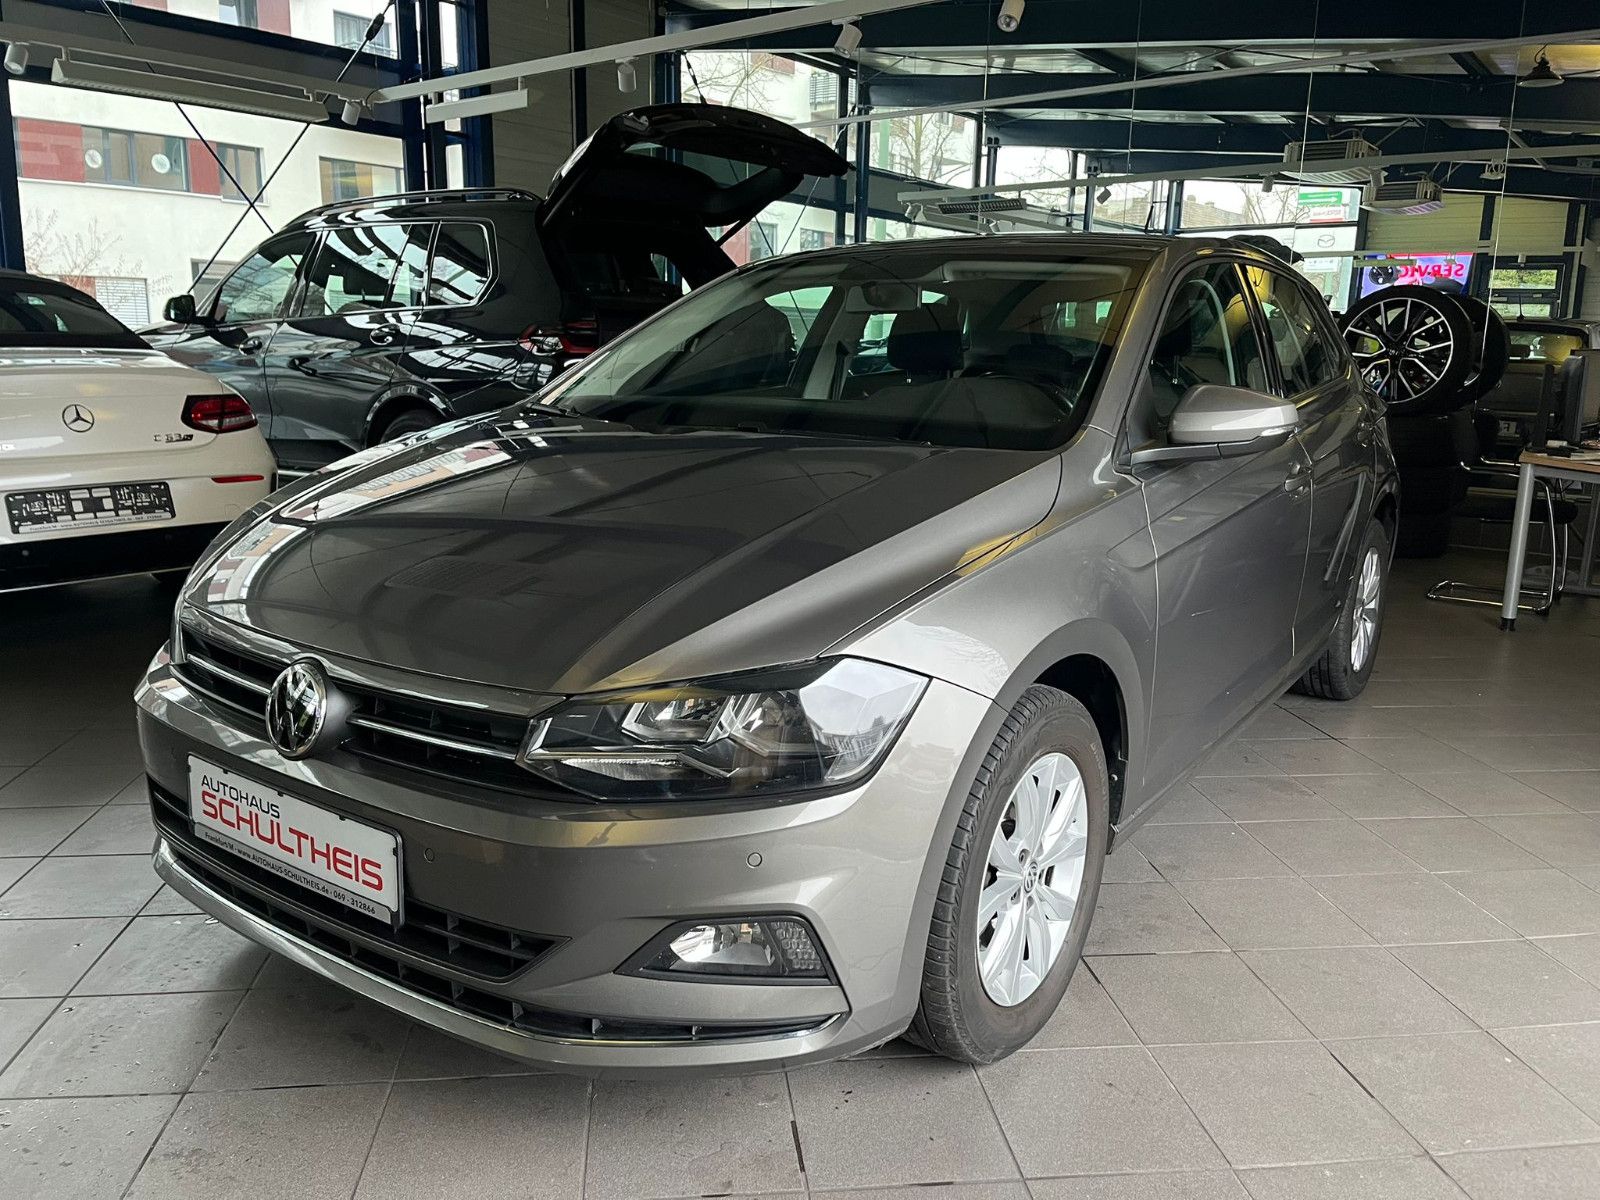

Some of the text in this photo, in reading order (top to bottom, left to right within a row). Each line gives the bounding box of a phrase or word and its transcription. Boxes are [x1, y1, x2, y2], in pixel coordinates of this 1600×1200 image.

[201, 774, 281, 819] AUTOHAUS
[201, 790, 383, 892] SCHULTHEIS
[333, 890, 346, 902] 069
